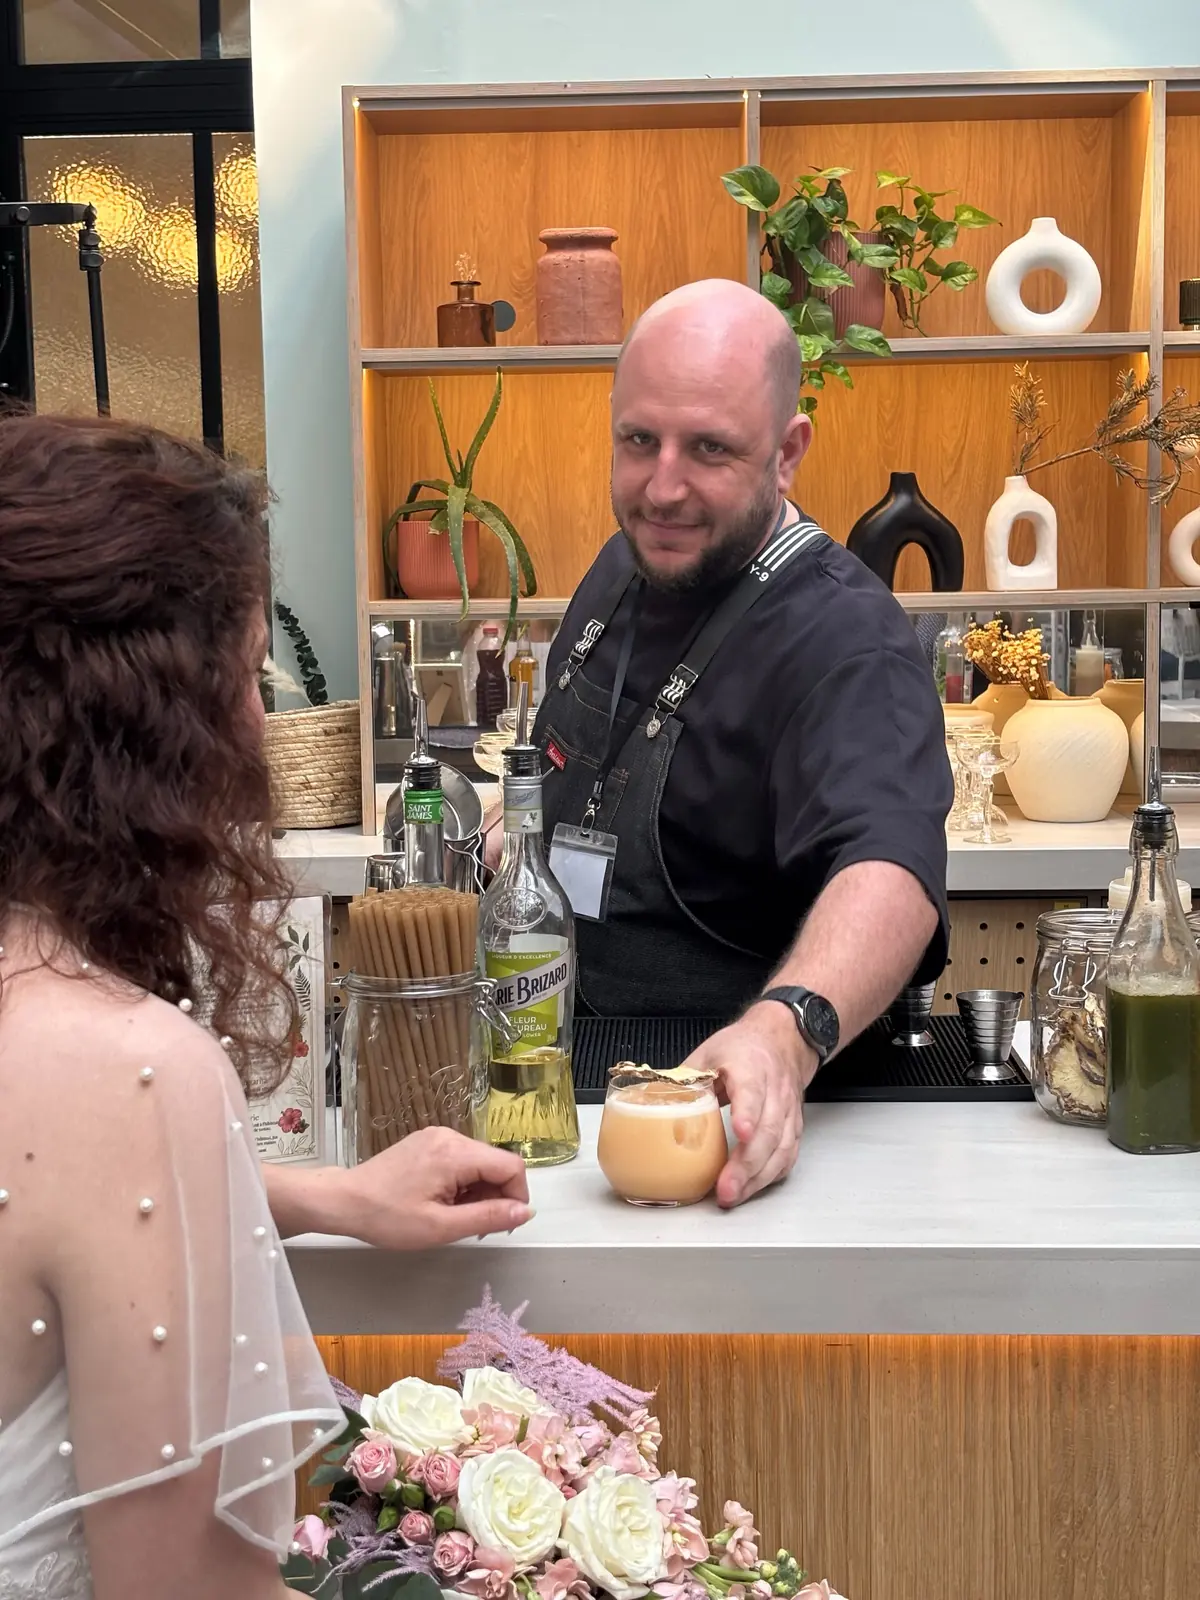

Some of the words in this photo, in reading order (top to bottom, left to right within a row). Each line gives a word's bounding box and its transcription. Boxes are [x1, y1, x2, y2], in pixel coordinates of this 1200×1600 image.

[749, 564, 770, 582] Y-9
[408, 803, 433, 812] SAINT
[406, 811, 433, 820] JAMES
[517, 962, 567, 1005] BRIZARD
[508, 1016, 537, 1024] FLEUR
